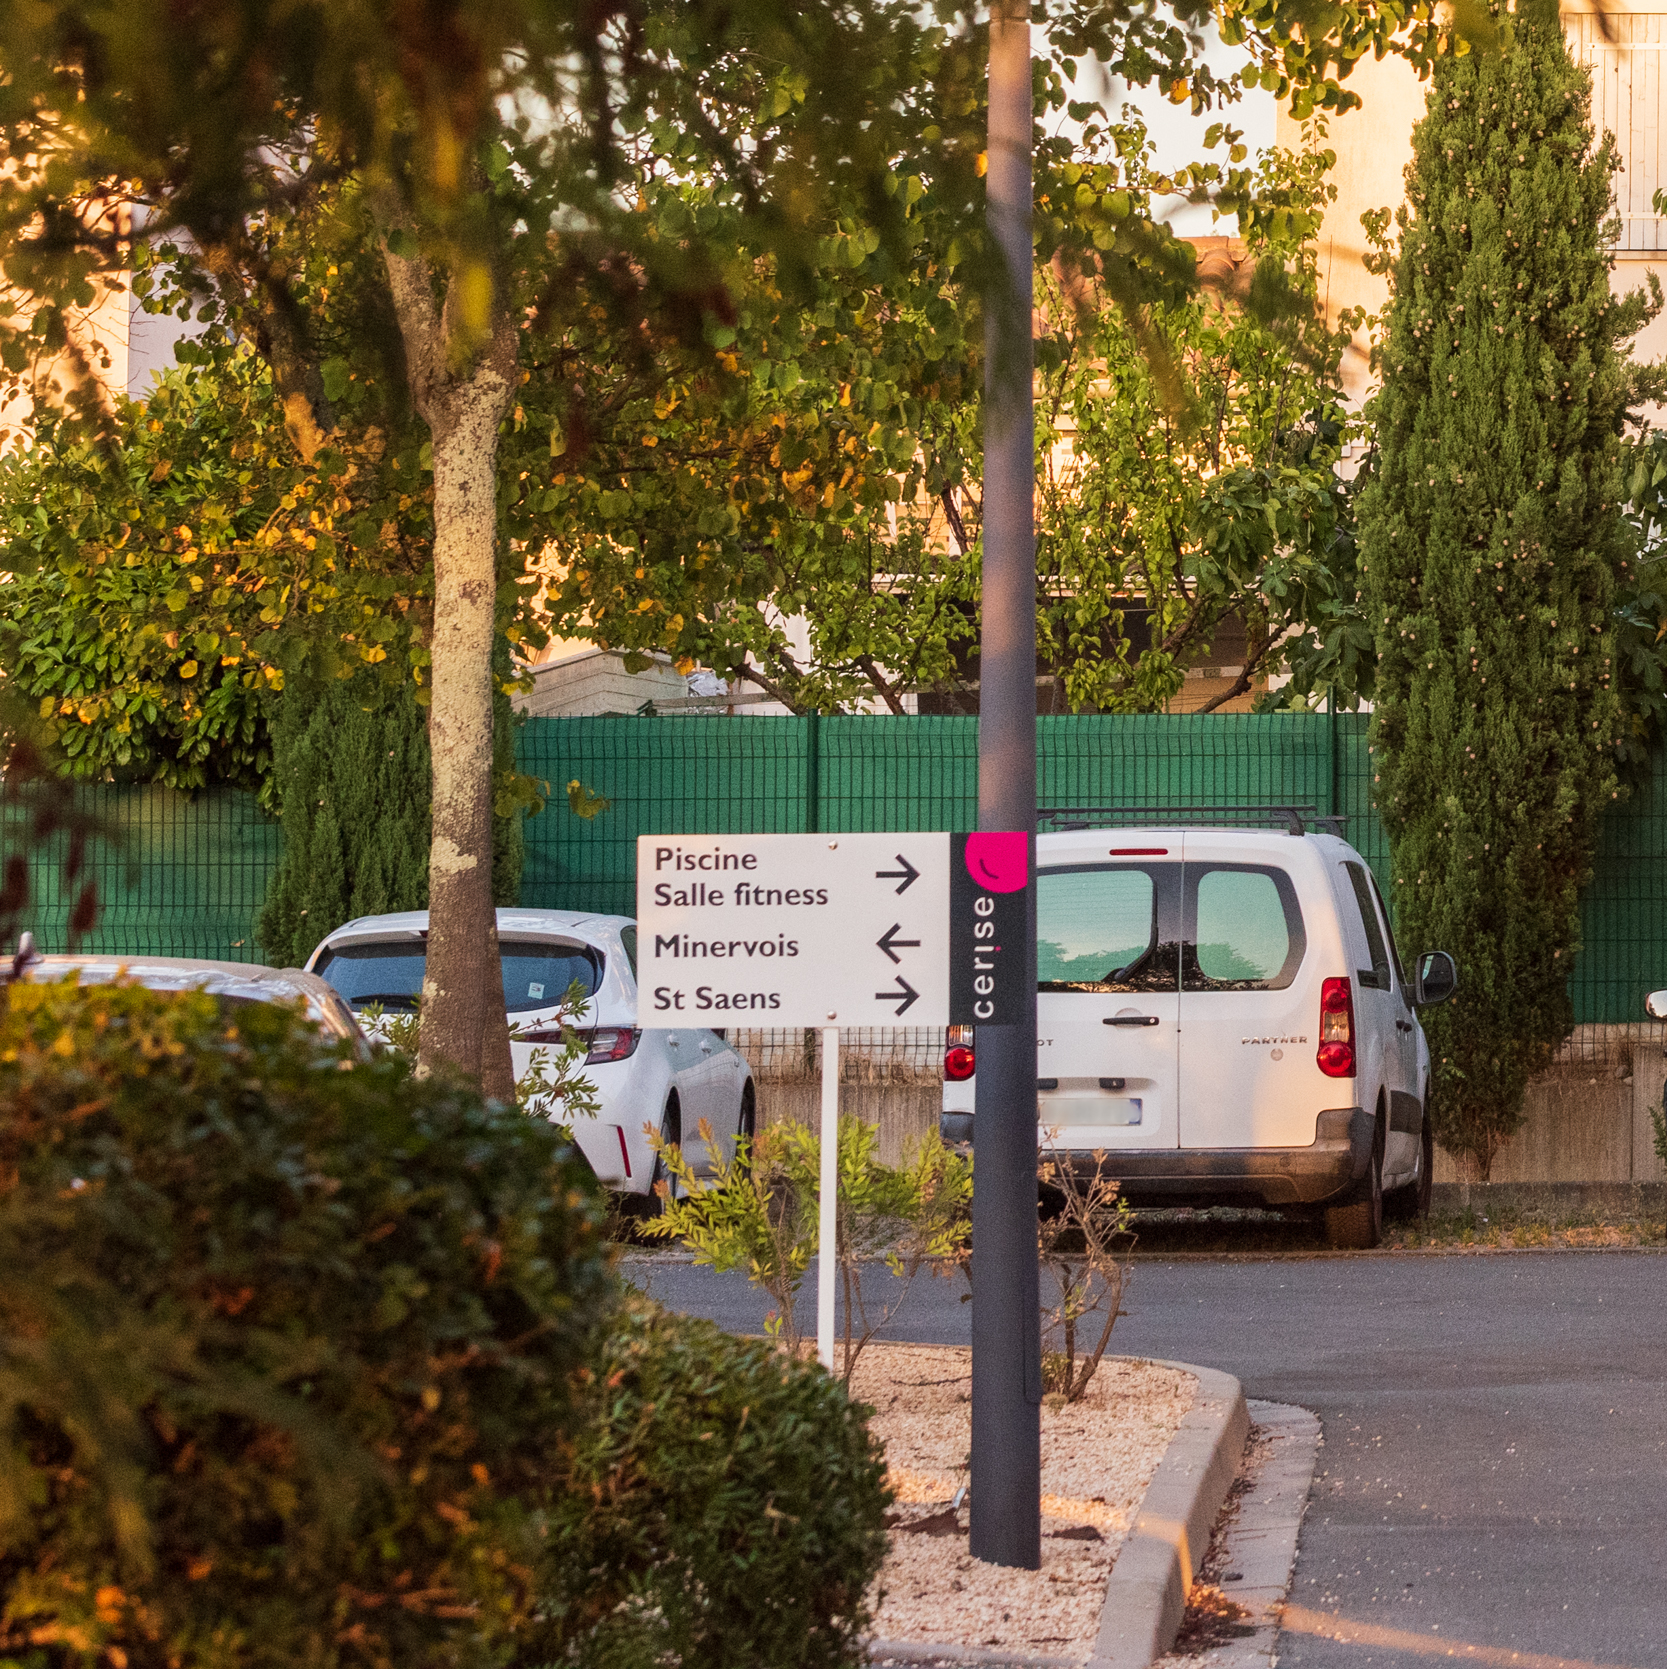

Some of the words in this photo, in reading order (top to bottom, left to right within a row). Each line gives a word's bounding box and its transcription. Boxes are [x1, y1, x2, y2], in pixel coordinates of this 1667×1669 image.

[655, 846, 758, 871] Piscine
[654, 882, 725, 907] Salle
[734, 882, 829, 907] fitness
[654, 933, 800, 958] Minervois
[973, 896, 999, 1019] cerise
[653, 986, 686, 1011] St
[695, 986, 782, 1011] Saens
[1241, 1036, 1308, 1045] PARTNER
